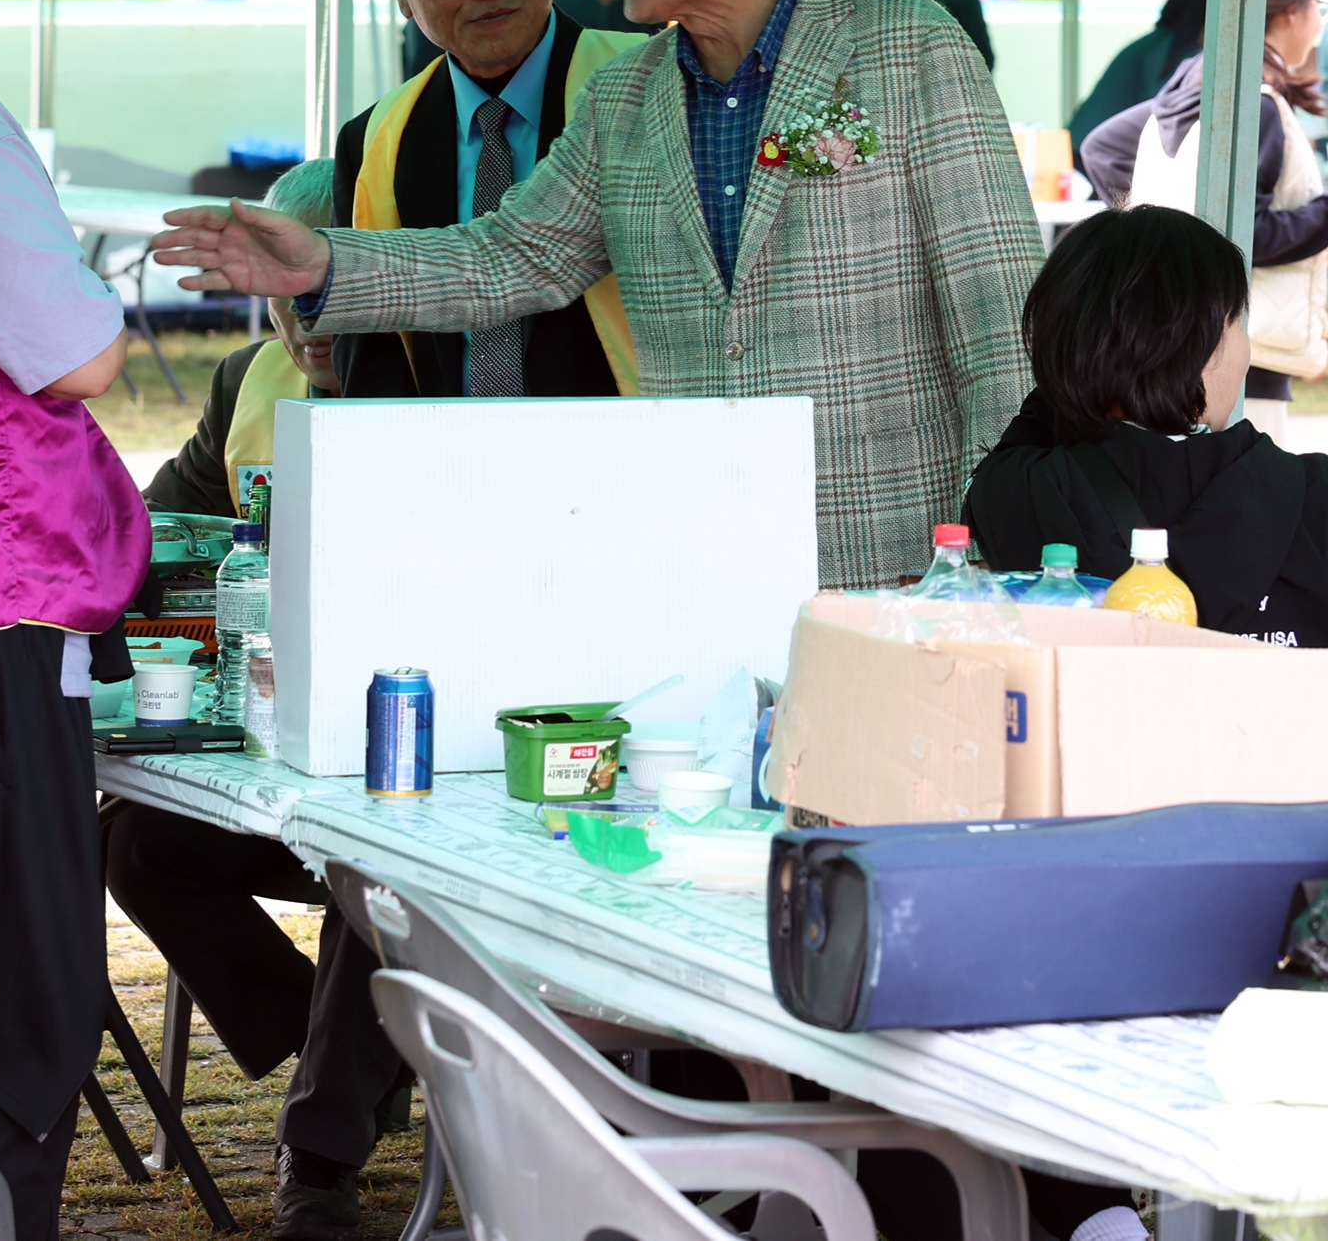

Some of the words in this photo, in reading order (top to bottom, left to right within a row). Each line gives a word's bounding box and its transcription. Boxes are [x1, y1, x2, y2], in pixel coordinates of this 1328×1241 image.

[1264, 630, 1298, 647] USA
[141, 689, 179, 699] Cleanlab
[547, 768, 571, 779] 사계절
[572, 767, 589, 779] 쌈장
